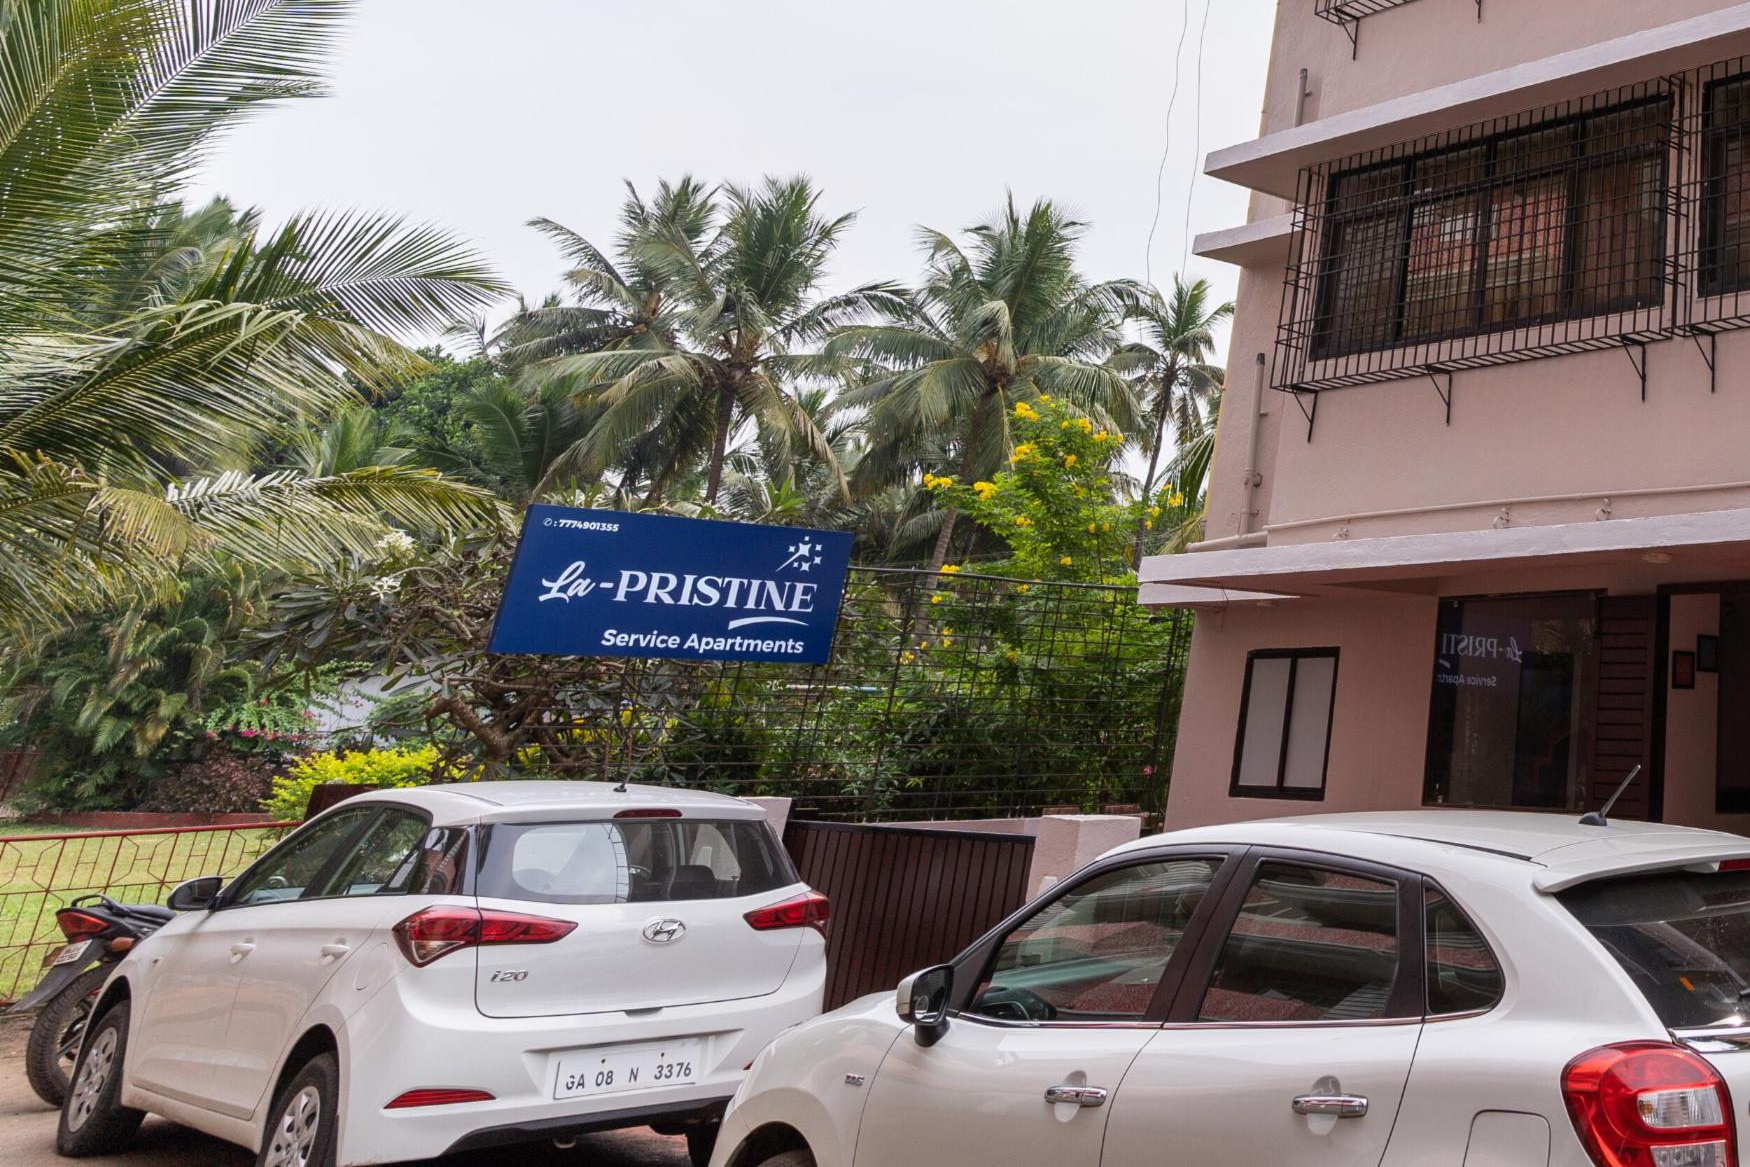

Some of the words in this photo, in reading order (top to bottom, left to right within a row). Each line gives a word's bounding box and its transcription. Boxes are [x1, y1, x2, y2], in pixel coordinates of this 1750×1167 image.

[601, 629, 680, 648] Service
[683, 633, 804, 653] Apartments
[490, 969, 529, 982] i20
[565, 1073, 585, 1090] GA
[595, 1070, 614, 1087] 08
[628, 1067, 639, 1083] N
[653, 1061, 692, 1081] 3376
